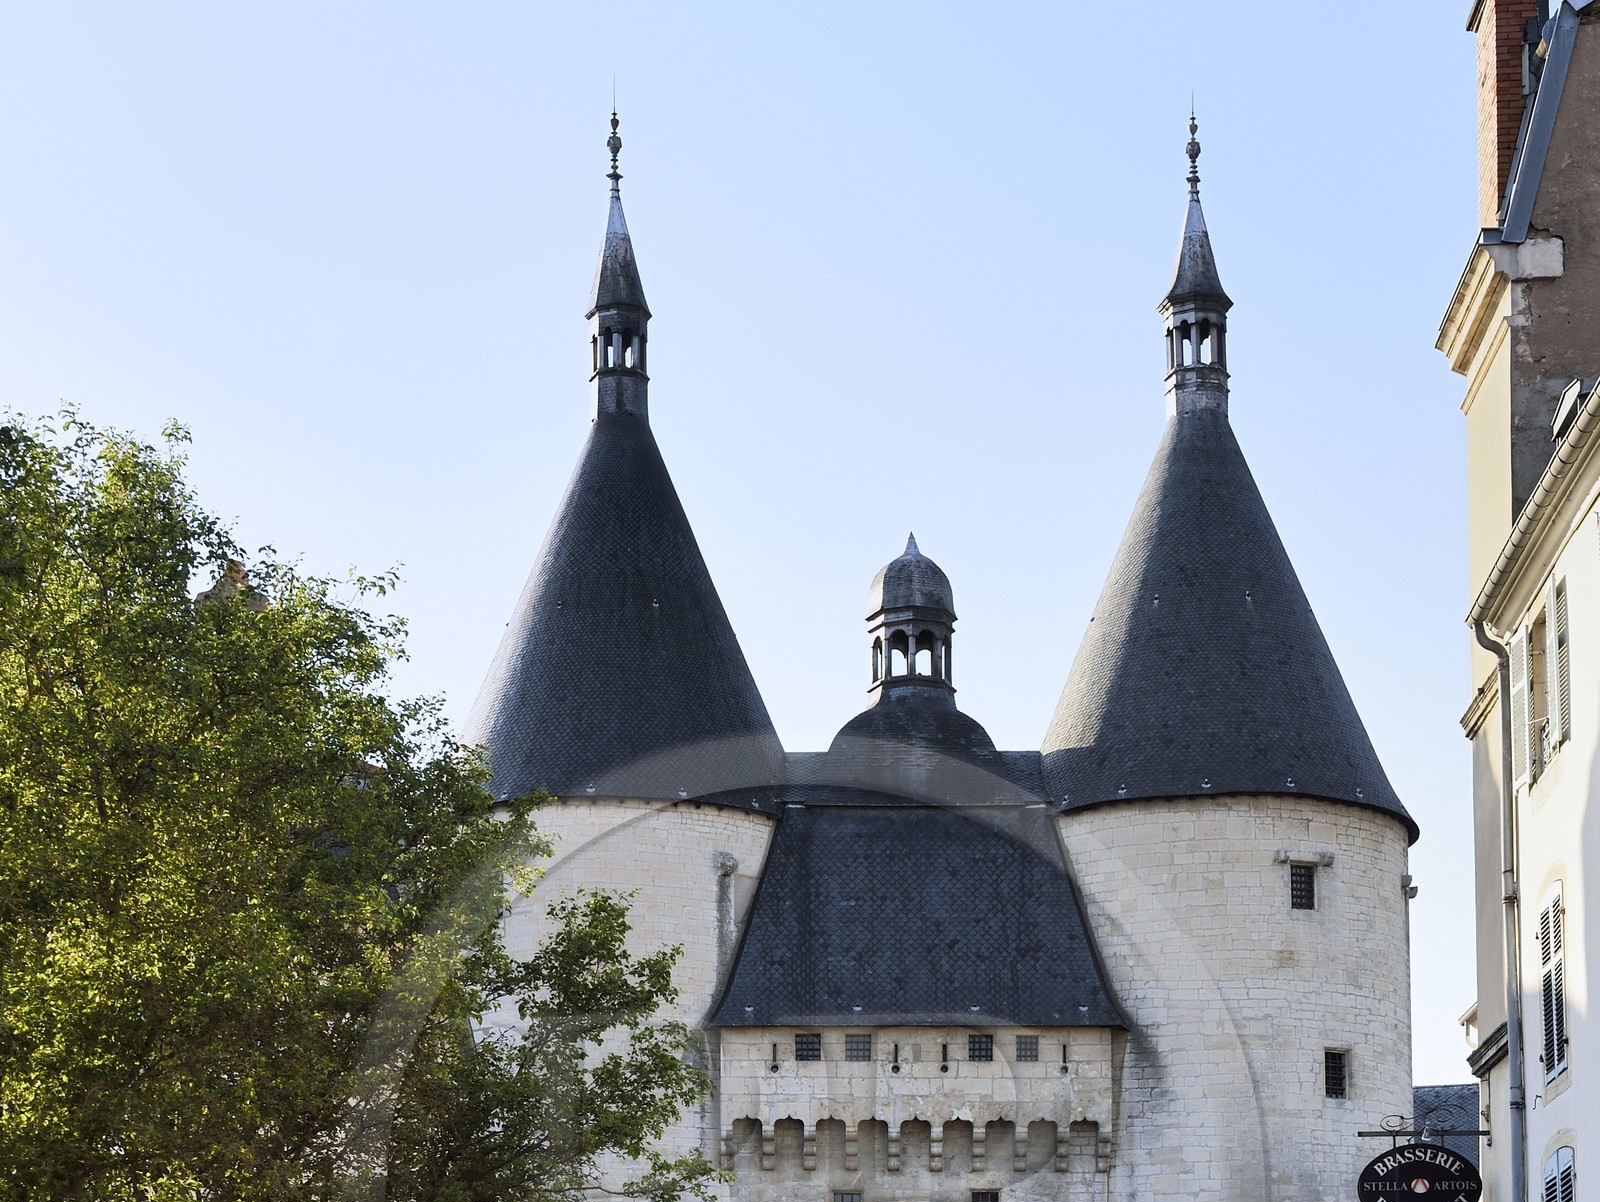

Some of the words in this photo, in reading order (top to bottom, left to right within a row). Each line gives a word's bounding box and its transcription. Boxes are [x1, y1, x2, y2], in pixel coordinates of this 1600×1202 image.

[1373, 1147, 1465, 1177] BRASSERIE
[1363, 1181, 1408, 1191] STELLA
[1433, 1180, 1478, 1191] ARTOIS
